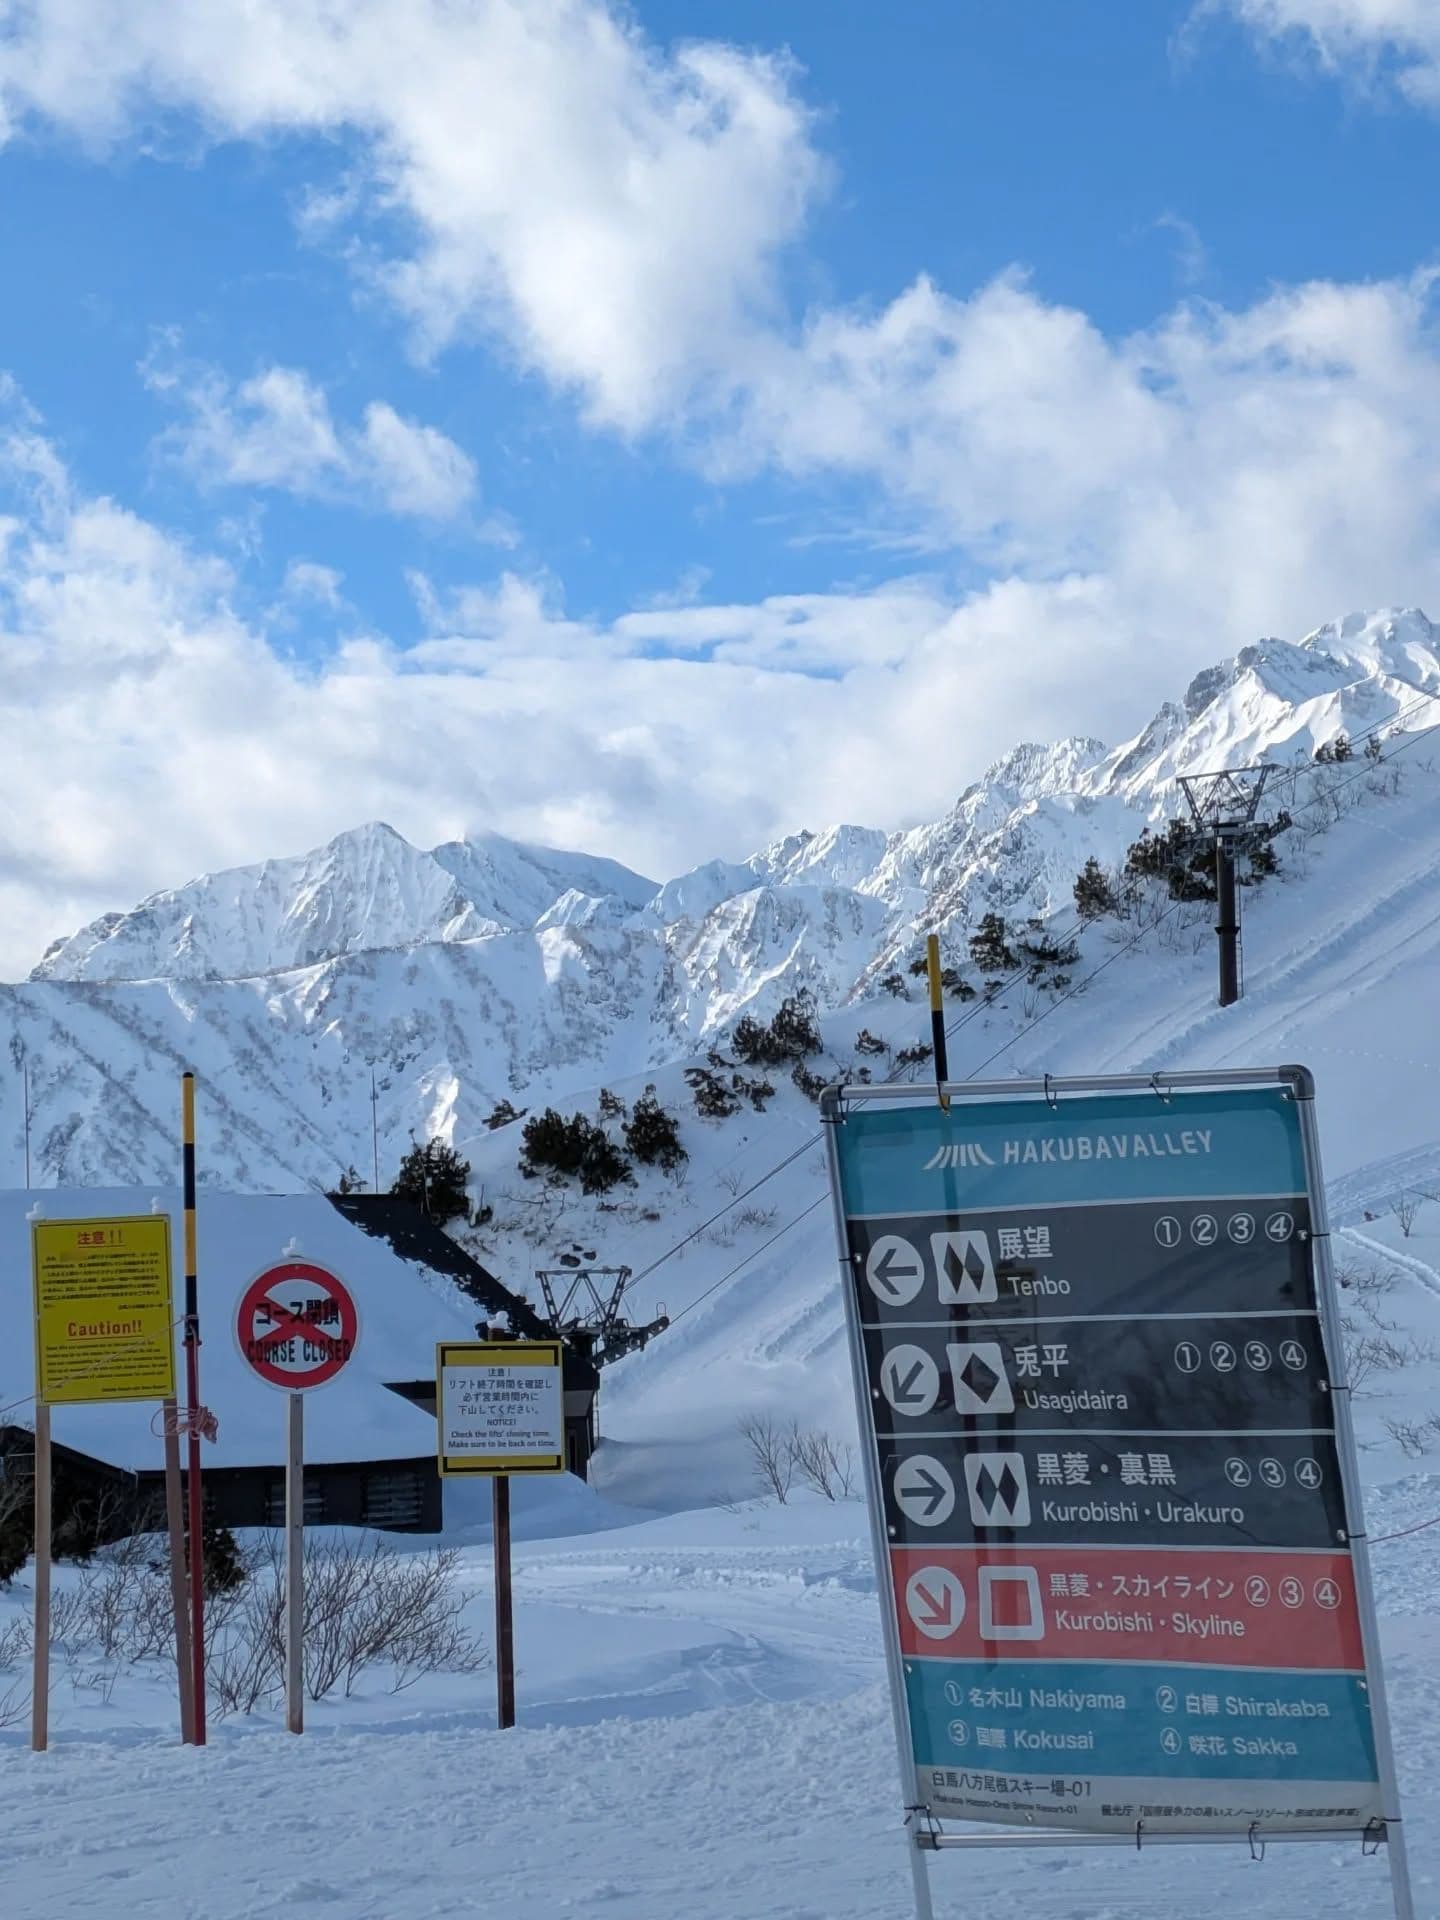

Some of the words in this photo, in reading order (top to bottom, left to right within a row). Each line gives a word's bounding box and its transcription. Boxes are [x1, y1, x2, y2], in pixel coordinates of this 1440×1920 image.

[1003, 1130, 1212, 1164] HAKUBAVALLEY
[997, 1226, 1053, 1259] 展望
[1008, 1276, 1070, 1297] Tenbo
[67, 1320, 142, 1336] Caution!!
[248, 1340, 296, 1363] COURSE
[303, 1339, 351, 1362] CLOSED
[1013, 1344, 1069, 1377] 兎平
[1023, 1390, 1128, 1414] Usagidaira
[1042, 1501, 1138, 1522] Kurobishi
[1157, 1502, 1244, 1523] Urakuro
[1055, 1609, 1153, 1632] Kurobishi
[1172, 1612, 1246, 1639] Skyline
[968, 1687, 1022, 1708] 名木山
[1030, 1689, 1127, 1712] Nakiyama
[1225, 1696, 1330, 1717] Shirakaba
[1014, 1730, 1094, 1750] Kokusai
[1232, 1736, 1298, 1757] Sakka
